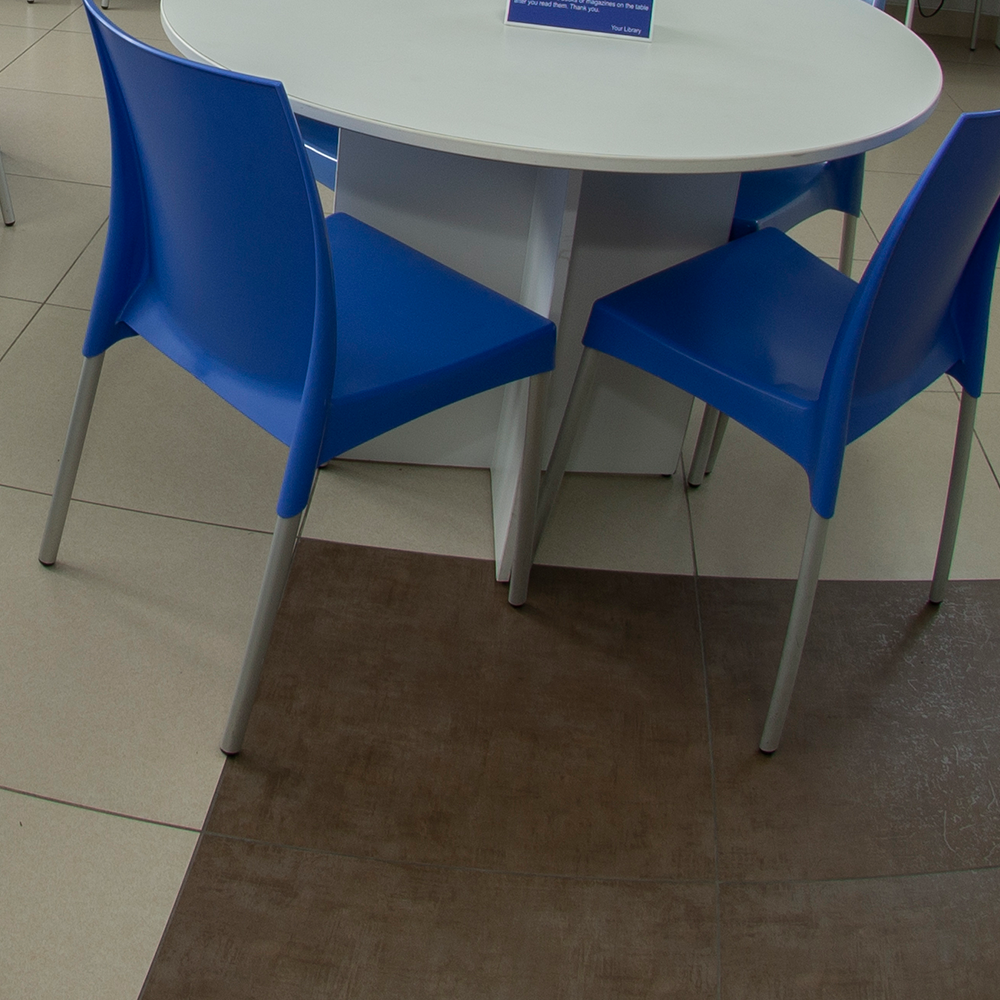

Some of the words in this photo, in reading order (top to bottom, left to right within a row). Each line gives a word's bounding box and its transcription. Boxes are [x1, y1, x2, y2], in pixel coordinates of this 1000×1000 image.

[570, 3, 587, 12] Thank
[586, 0, 616, 8] magazines
[625, 2, 635, 10] the
[635, 4, 650, 12] table
[611, 24, 624, 32] Your
[624, 26, 642, 35] Library
